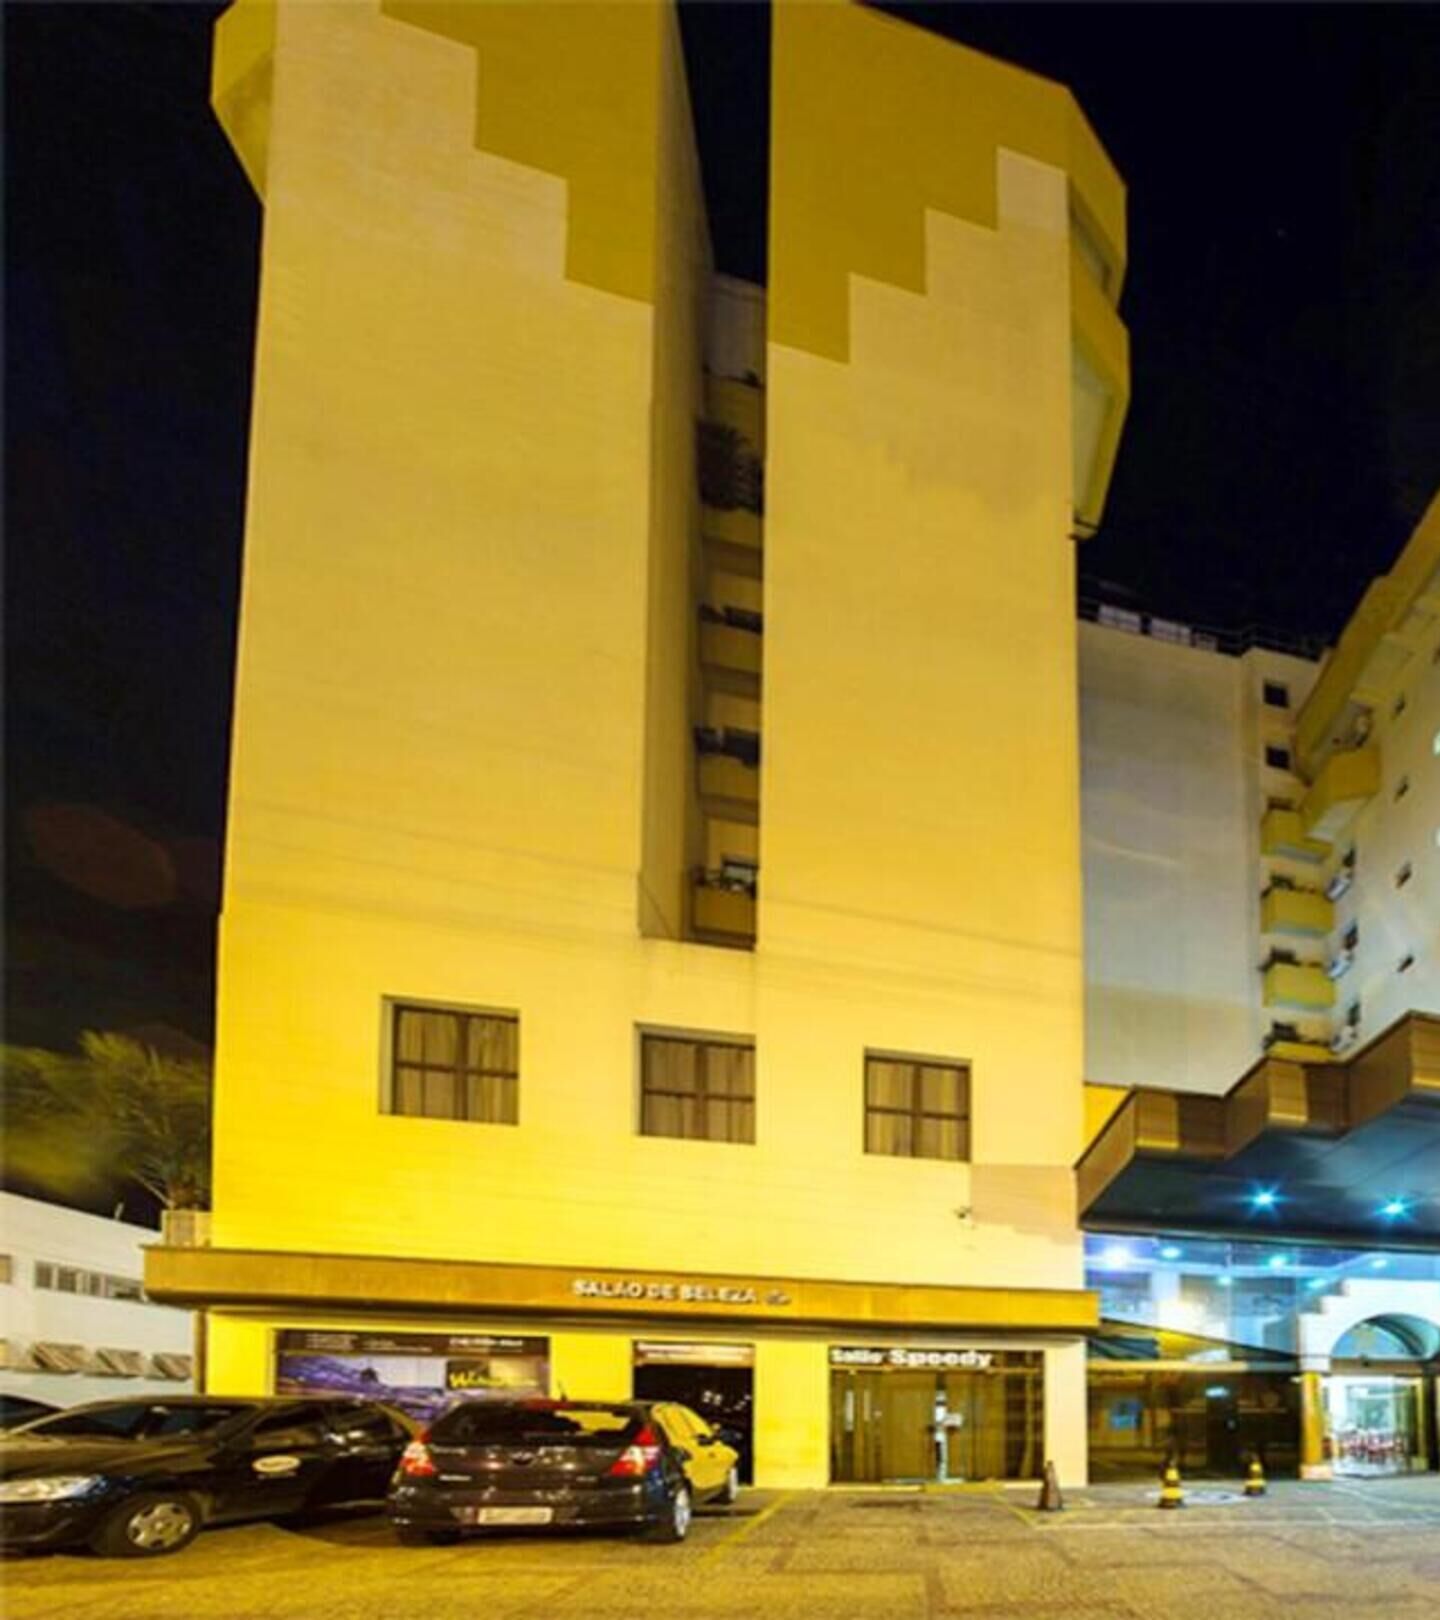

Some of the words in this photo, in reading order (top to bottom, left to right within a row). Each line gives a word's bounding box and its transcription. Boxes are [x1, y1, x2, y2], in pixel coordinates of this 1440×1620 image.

[647, 1283, 675, 1300] DE
[679, 1284, 757, 1304] BELEZA
[888, 1347, 993, 1368] Speedy
